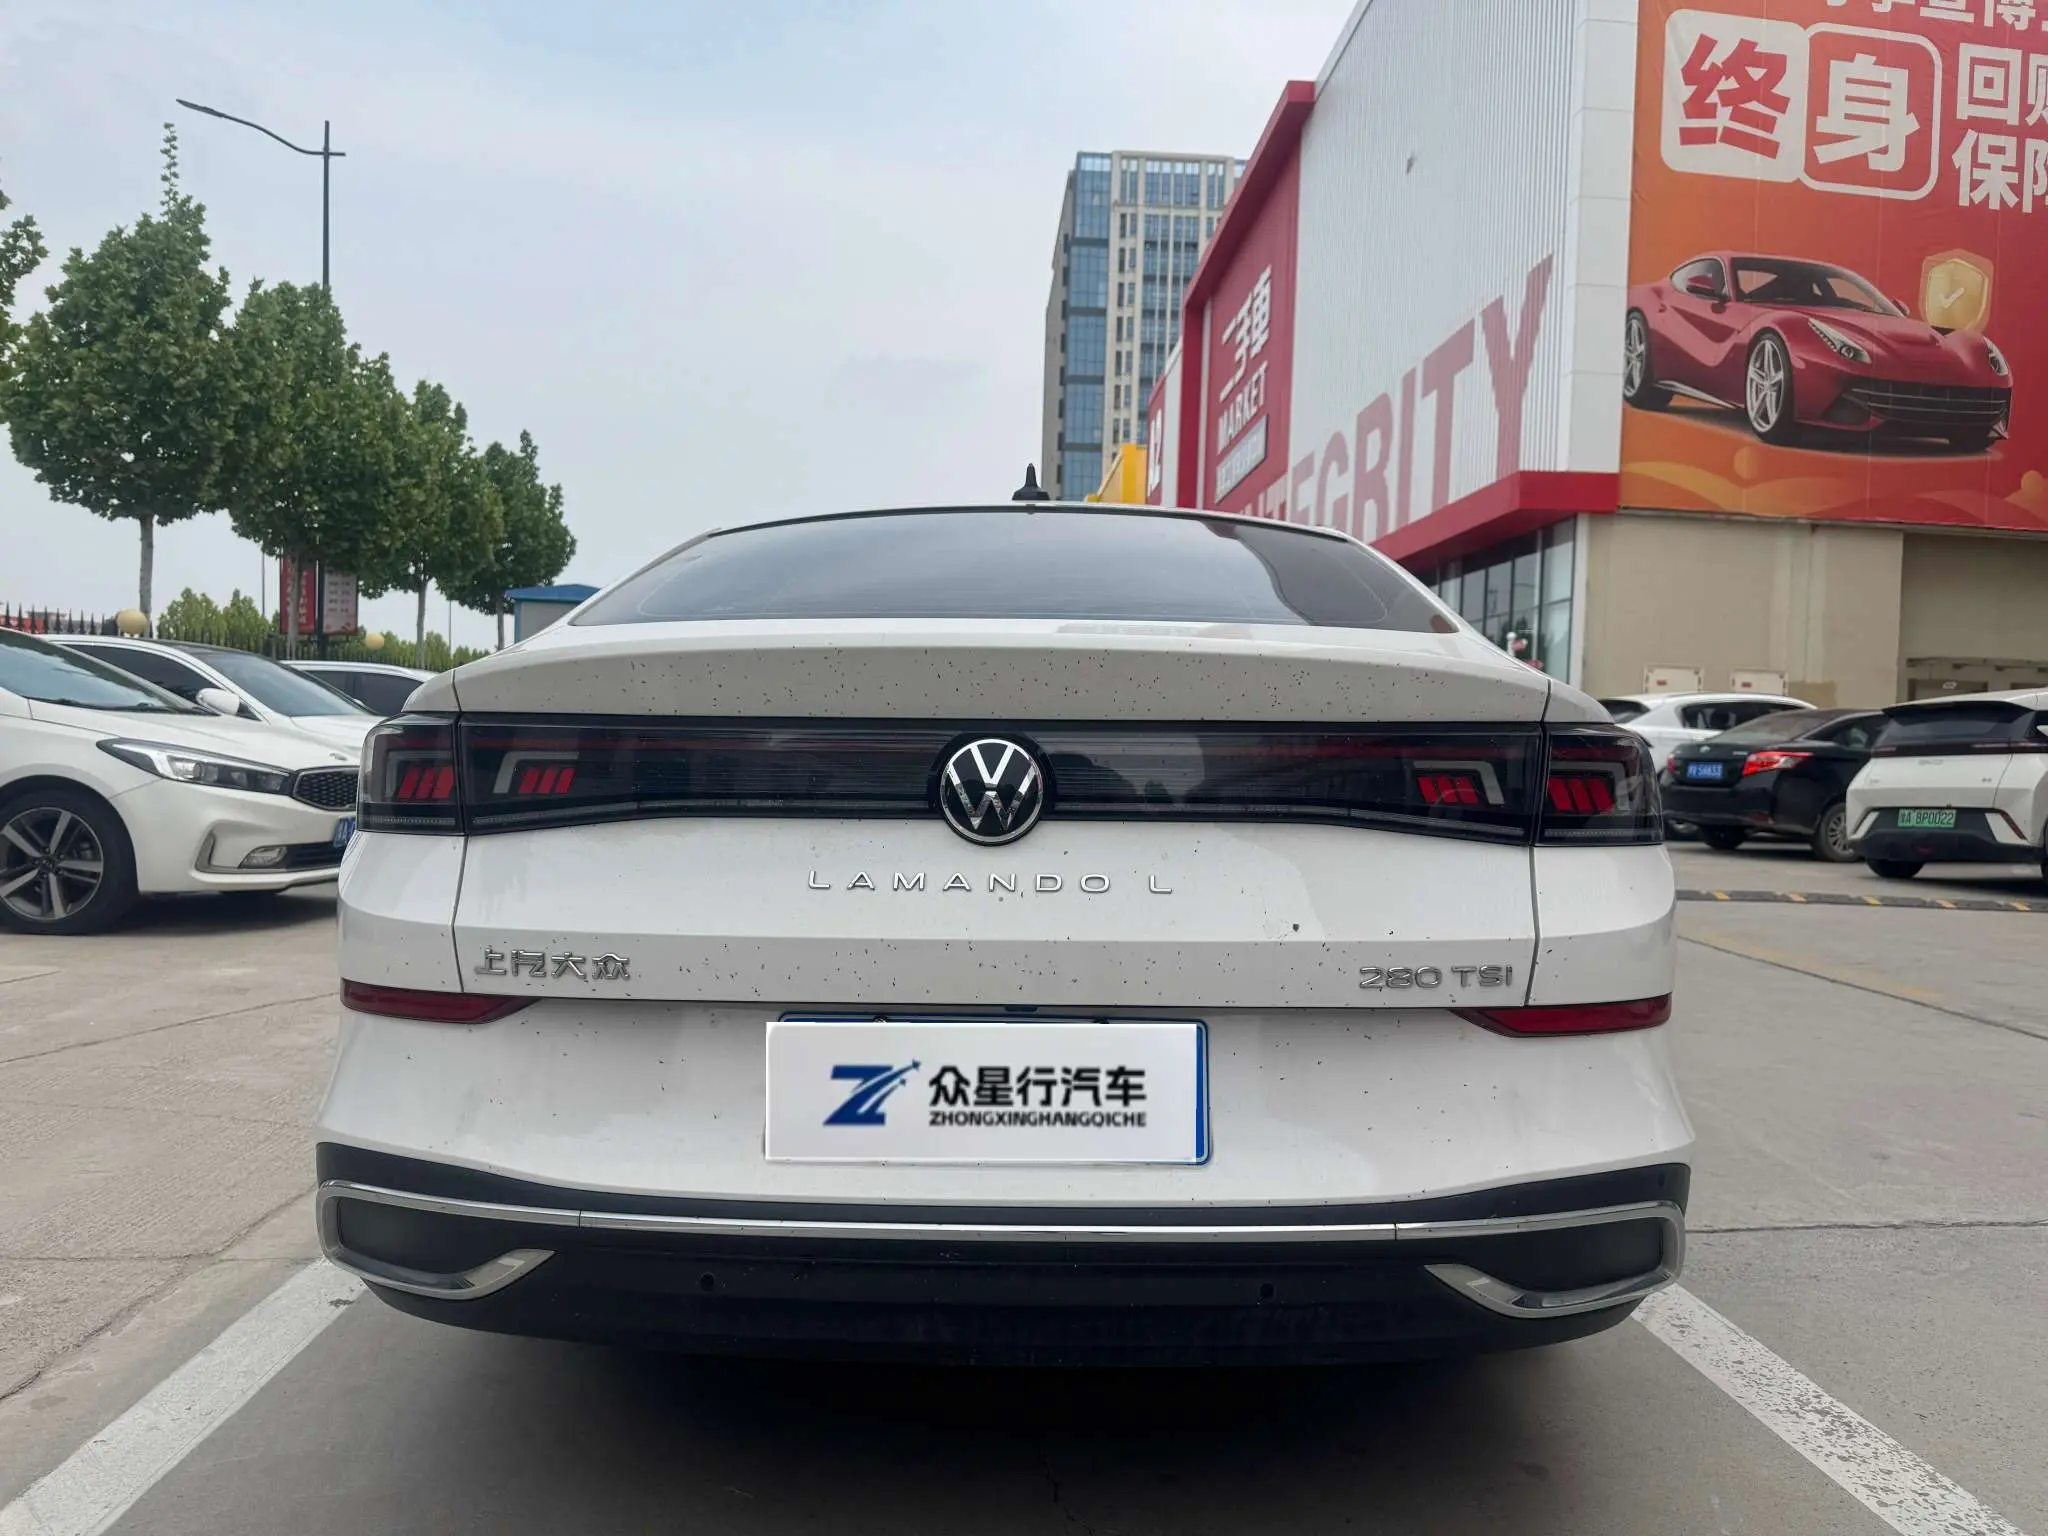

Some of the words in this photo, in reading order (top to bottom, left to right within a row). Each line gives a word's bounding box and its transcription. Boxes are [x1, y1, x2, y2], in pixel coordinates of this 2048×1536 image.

[1679, 33, 1920, 172] 终身
[1217, 360, 1268, 457] MARKET
[808, 870, 1111, 894] LAMANDO
[1148, 874, 1173, 894] L
[473, 948, 631, 980] 上汽大众
[1359, 965, 1443, 989] 280
[1451, 964, 1514, 988] TSI
